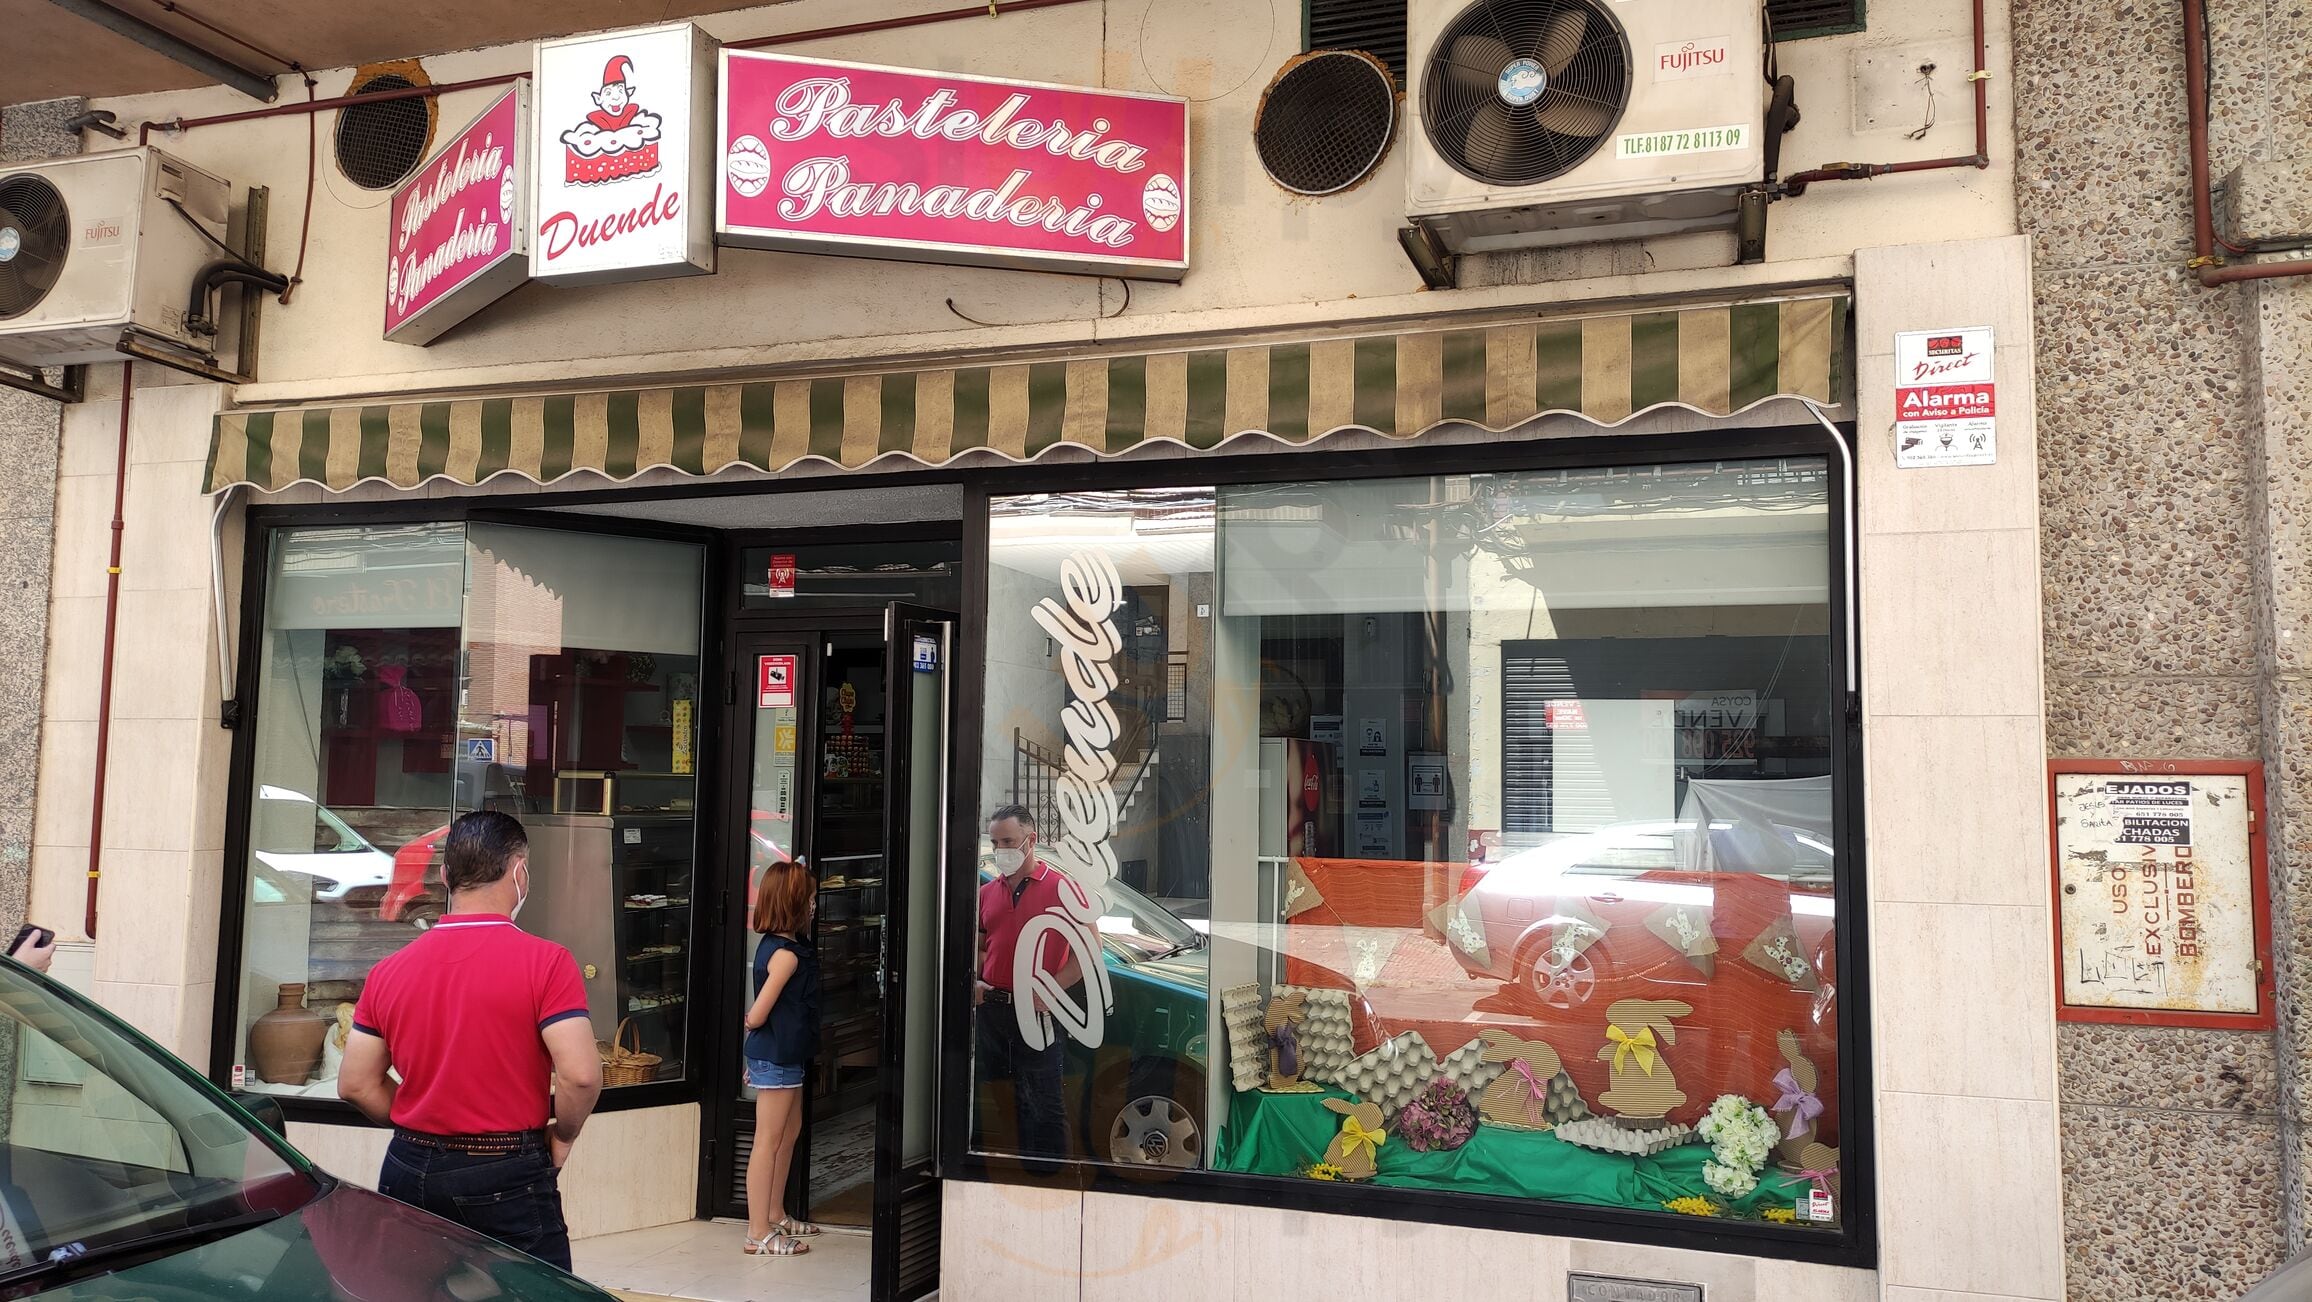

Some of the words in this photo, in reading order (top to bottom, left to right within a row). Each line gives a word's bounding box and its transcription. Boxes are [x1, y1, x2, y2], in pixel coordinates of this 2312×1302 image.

[1661, 47, 1724, 72] FUJITSU
[769, 76, 1148, 174] Pasteleria
[1676, 134, 1689, 150] 72
[1694, 130, 1722, 149] 8113
[1726, 128, 1741, 146] 09
[399, 132, 504, 252] Pasteleria
[777, 155, 1137, 249] Panaderia
[85, 222, 120, 241] FUJITSU
[540, 183, 681, 261] Duende
[398, 208, 498, 316] Panaderia
[1913, 352, 1981, 380] Direct
[1903, 390, 1989, 408] Alarma
[1922, 408, 1948, 416] Aviso
[1959, 406, 1990, 415] Policía
[1013, 549, 1122, 1052] Duende
[2105, 785, 2186, 794] EJADOS
[2123, 828, 2180, 836] CHADAS
[2124, 819, 2189, 827] BILITACION
[2111, 867, 2129, 914] USO
[2142, 846, 2162, 957] EXCLUSIV
[1586, 1283, 1682, 1301] CONTADOR
